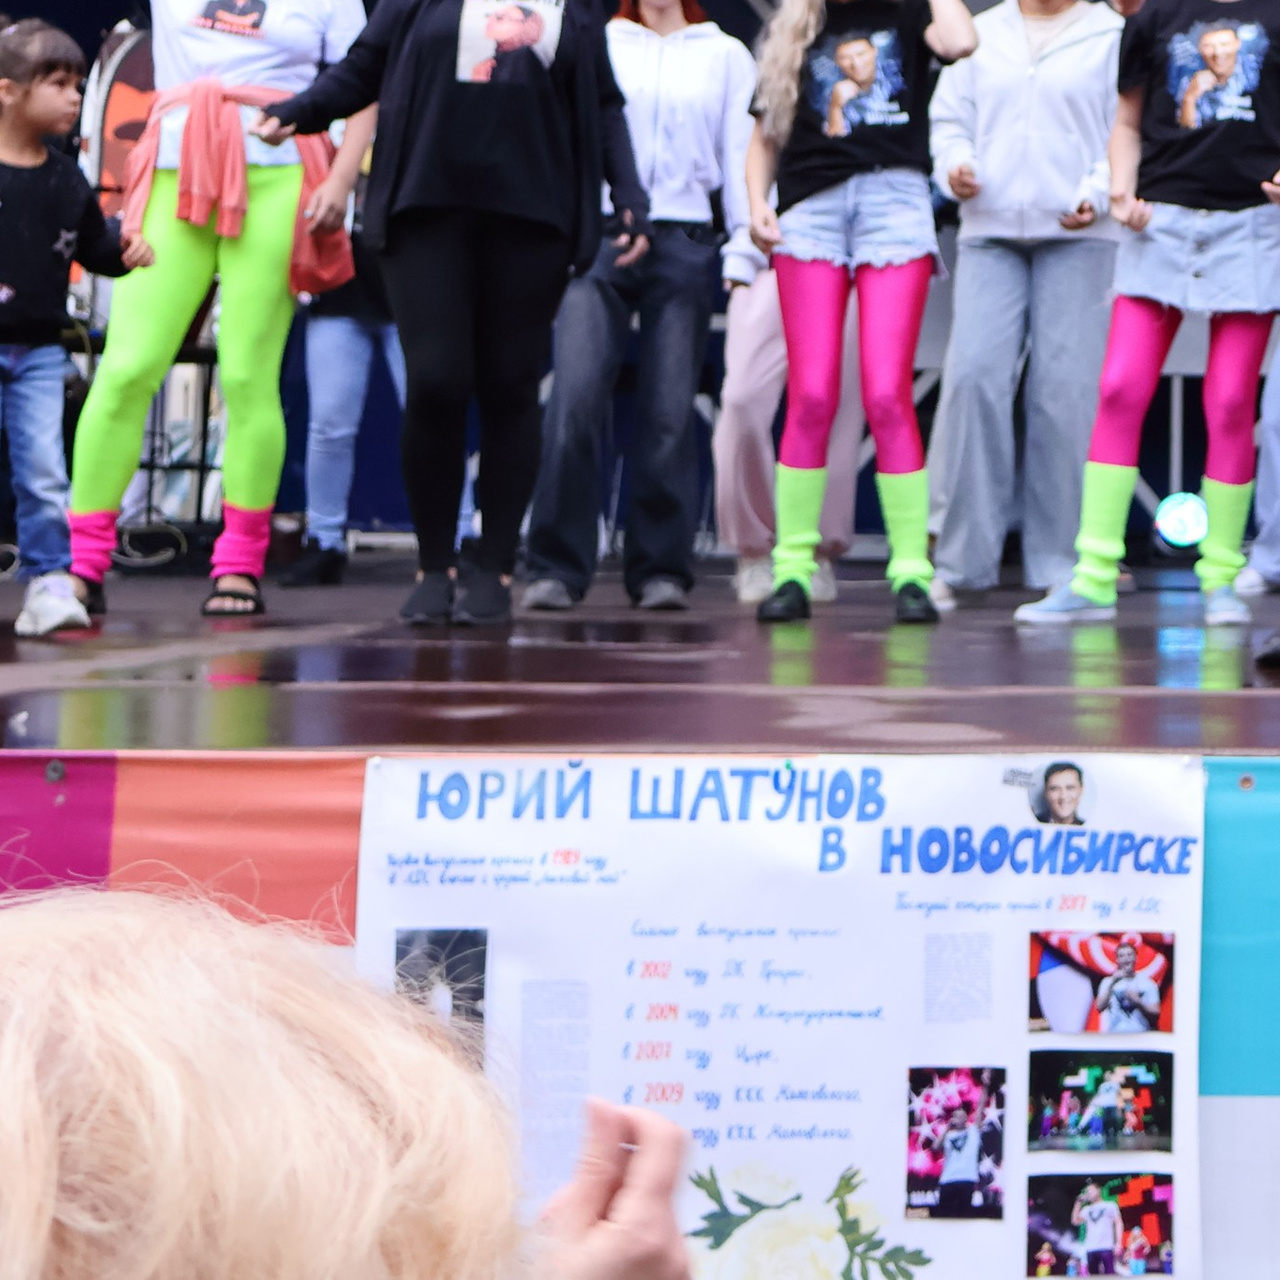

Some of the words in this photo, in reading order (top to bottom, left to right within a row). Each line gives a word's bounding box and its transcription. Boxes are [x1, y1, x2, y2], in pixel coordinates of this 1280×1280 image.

[416, 759, 593, 820] ЮРИЙ
[629, 765, 886, 822] ШАТУНОВ
[818, 826, 846, 872] В
[880, 825, 1198, 876] НОВОСИБИРСКЕ
